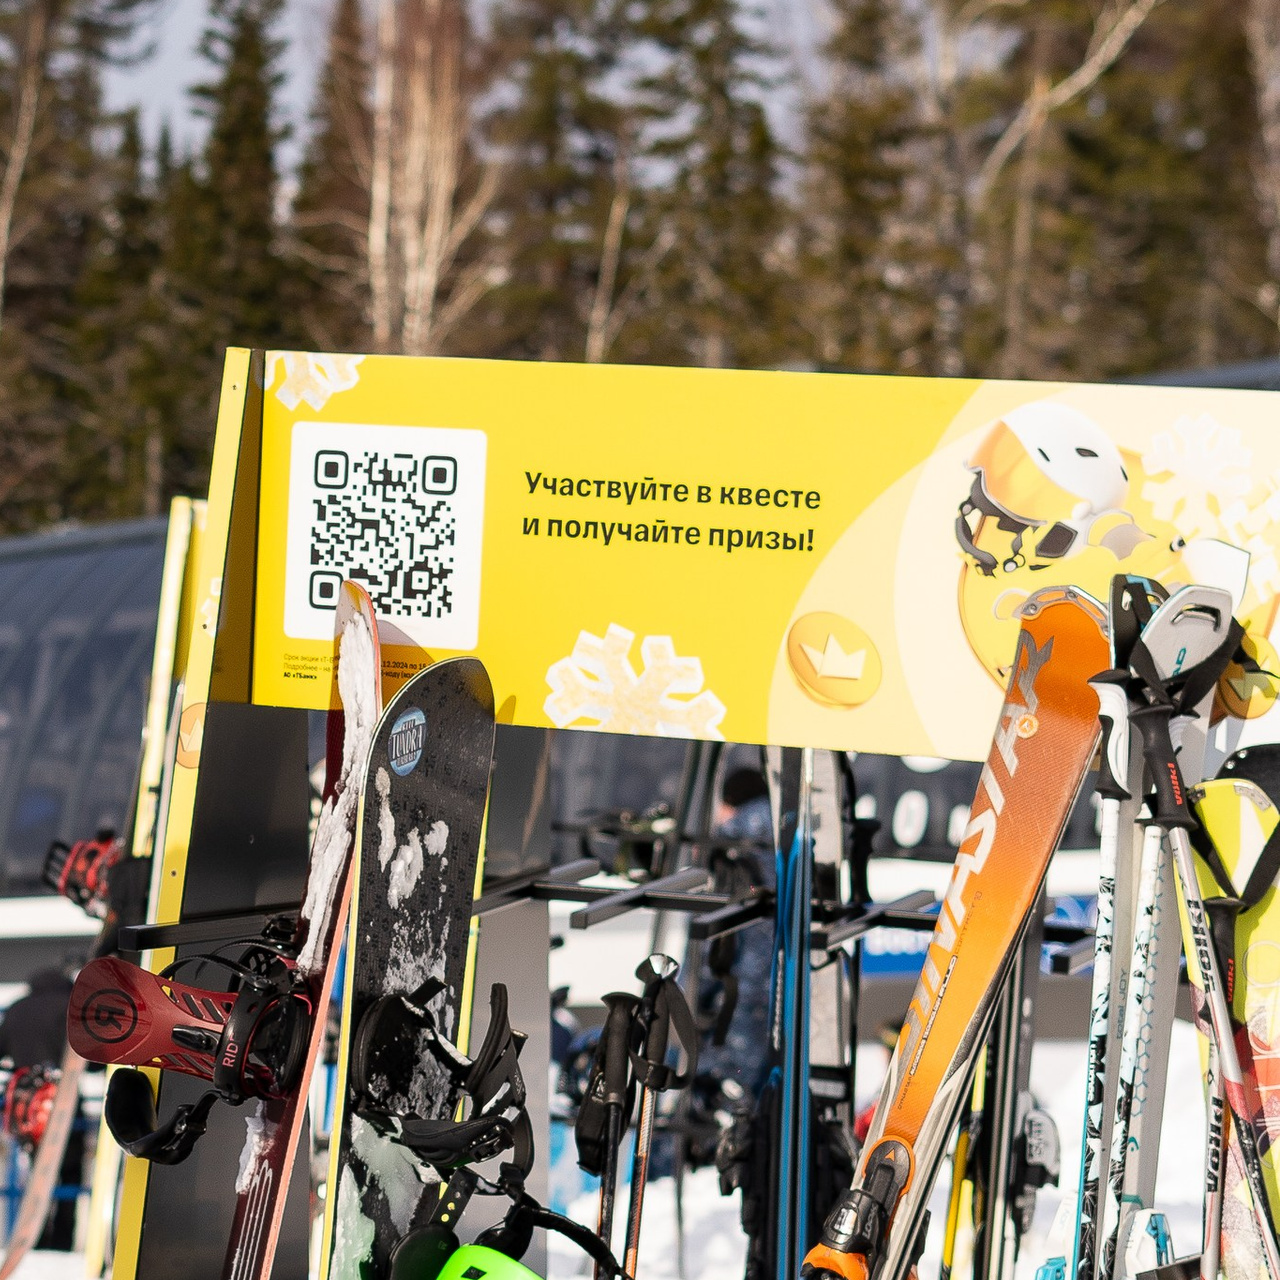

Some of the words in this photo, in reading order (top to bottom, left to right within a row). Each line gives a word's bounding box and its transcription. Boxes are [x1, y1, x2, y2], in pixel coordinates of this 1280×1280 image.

[524, 471, 689, 505] Участвуйте
[697, 485, 711, 503] в
[720, 486, 821, 509] квесте
[522, 517, 539, 536] и
[546, 518, 701, 546] получайте
[708, 528, 815, 553] призы!
[392, 724, 423, 759] TUNDRA
[861, 1202, 879, 1240] LOOK
